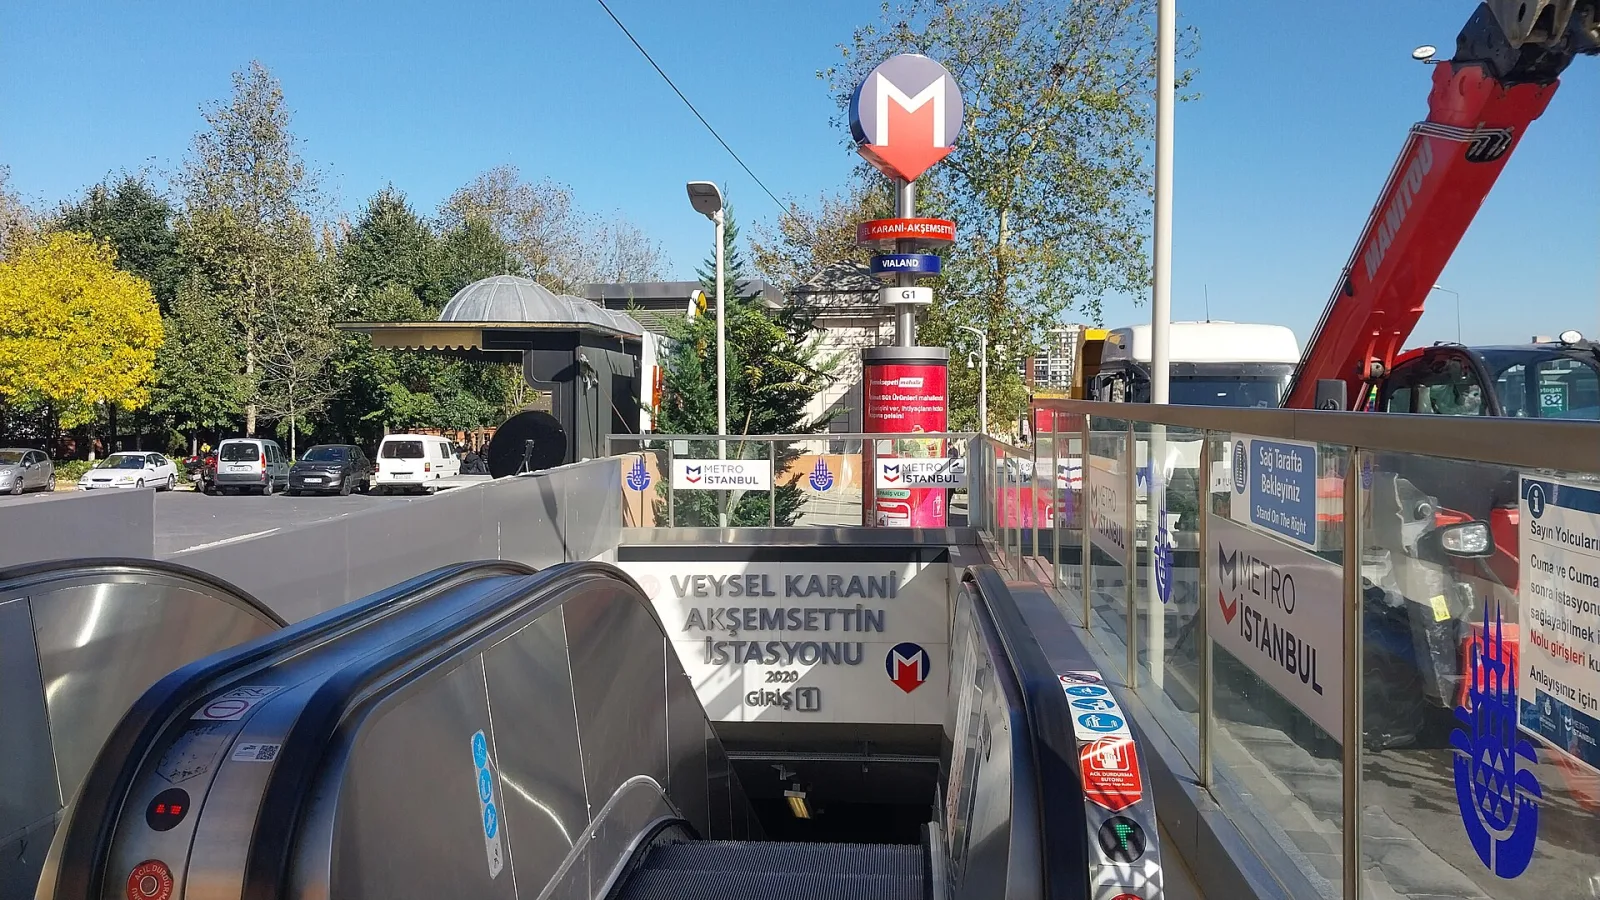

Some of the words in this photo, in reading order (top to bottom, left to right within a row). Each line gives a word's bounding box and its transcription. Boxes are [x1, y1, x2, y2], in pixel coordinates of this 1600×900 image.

[1364, 137, 1433, 282] MANITOU
[882, 258, 919, 268] VIALAND
[901, 290, 916, 299] G1
[892, 393, 918, 401] Ürünleri
[1544, 394, 1562, 406] 82
[704, 465, 744, 474] METRO
[902, 463, 943, 472] METRO
[1259, 446, 1273, 472] Sağ
[1275, 448, 1303, 473] Tarafta
[704, 474, 760, 485] İSTANBUL
[902, 474, 959, 483] İSTANBUL
[1261, 473, 1301, 504] Bekleyiniz
[1256, 504, 1271, 522] Stand
[1271, 509, 1280, 525] On
[1280, 512, 1290, 528] The
[1290, 516, 1307, 536] Right
[1530, 520, 1553, 540] Sayın
[1240, 551, 1296, 615] METRO
[1530, 554, 1554, 574] Cuma
[1556, 565, 1566, 579] ve
[1568, 565, 1599, 588] Cuma
[669, 574, 776, 599] VEYSEL
[785, 570, 897, 600] KARANİ
[1530, 582, 1553, 600] sonra
[682, 603, 886, 636] AKŞEMSETTİN
[1530, 607, 1594, 643] sağlayabilmek
[703, 636, 863, 665] İSTASYONU
[1240, 593, 1323, 697] İSTANBUL
[1530, 628, 1549, 650] Nolu
[1551, 640, 1586, 667] girişleri
[764, 670, 799, 684] 2020
[1529, 665, 1576, 701] Anlayışınız
[1578, 688, 1598, 711] için
[744, 688, 793, 710] GİRİŞ
